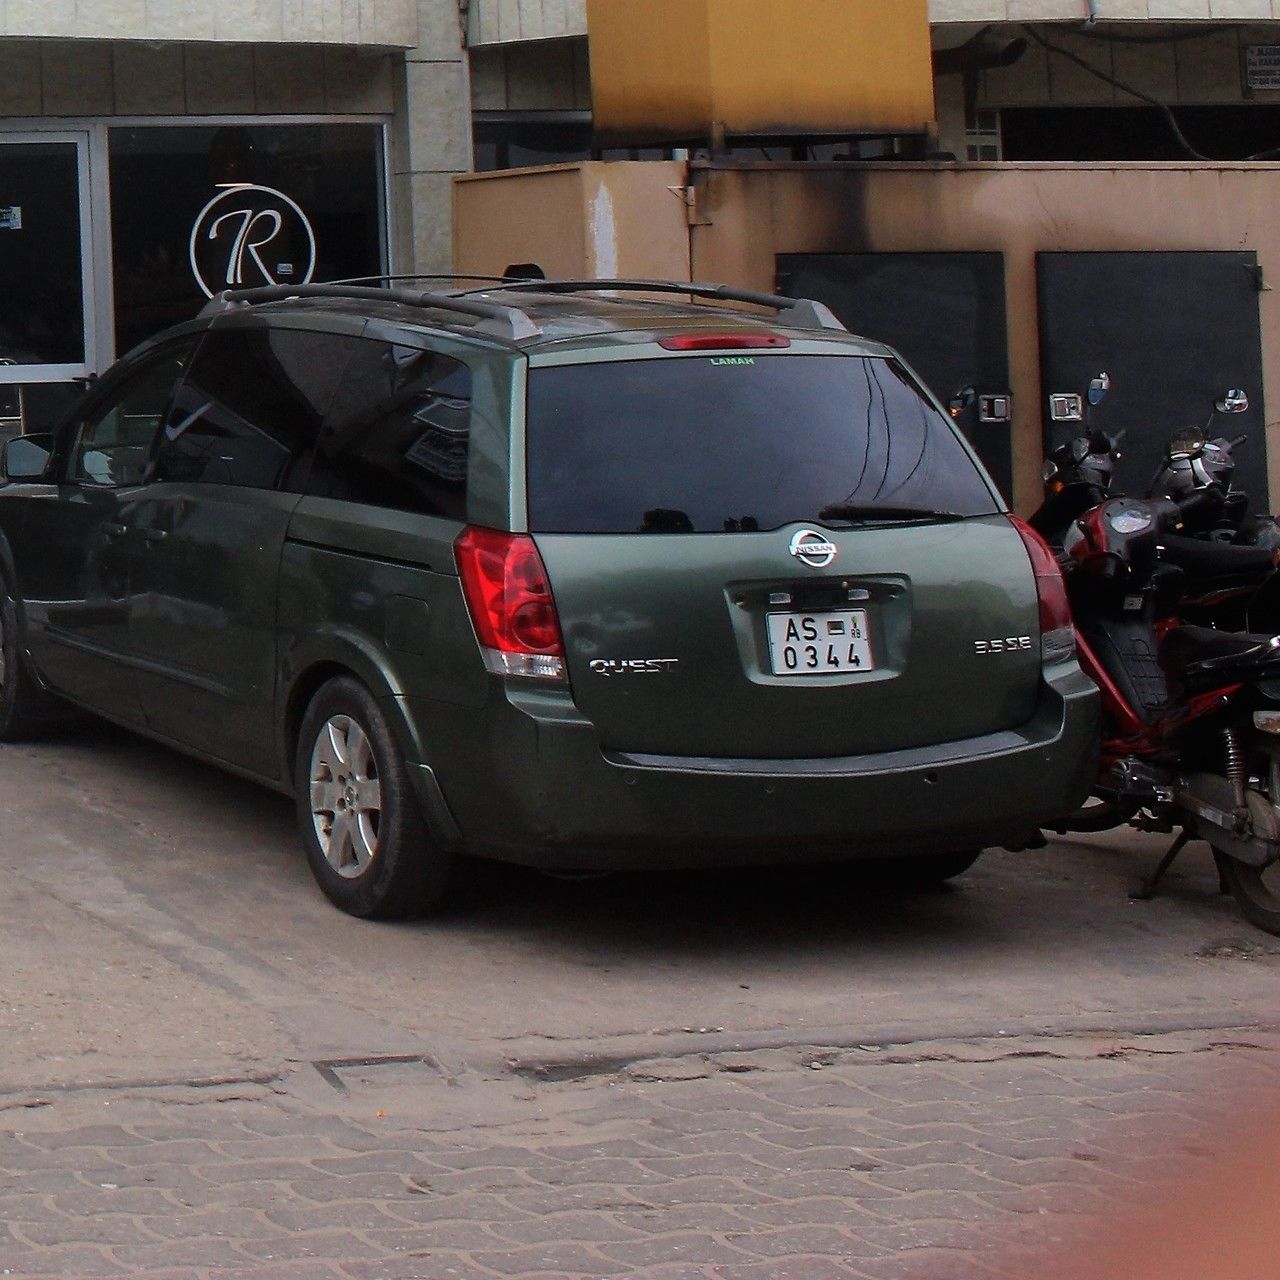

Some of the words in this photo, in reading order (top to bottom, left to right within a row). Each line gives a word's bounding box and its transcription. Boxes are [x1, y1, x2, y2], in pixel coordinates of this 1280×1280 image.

[795, 544, 834, 554] NISSAN
[785, 617, 818, 642] AS
[783, 643, 861, 669] 0344
[589, 658, 680, 677] QUEST
